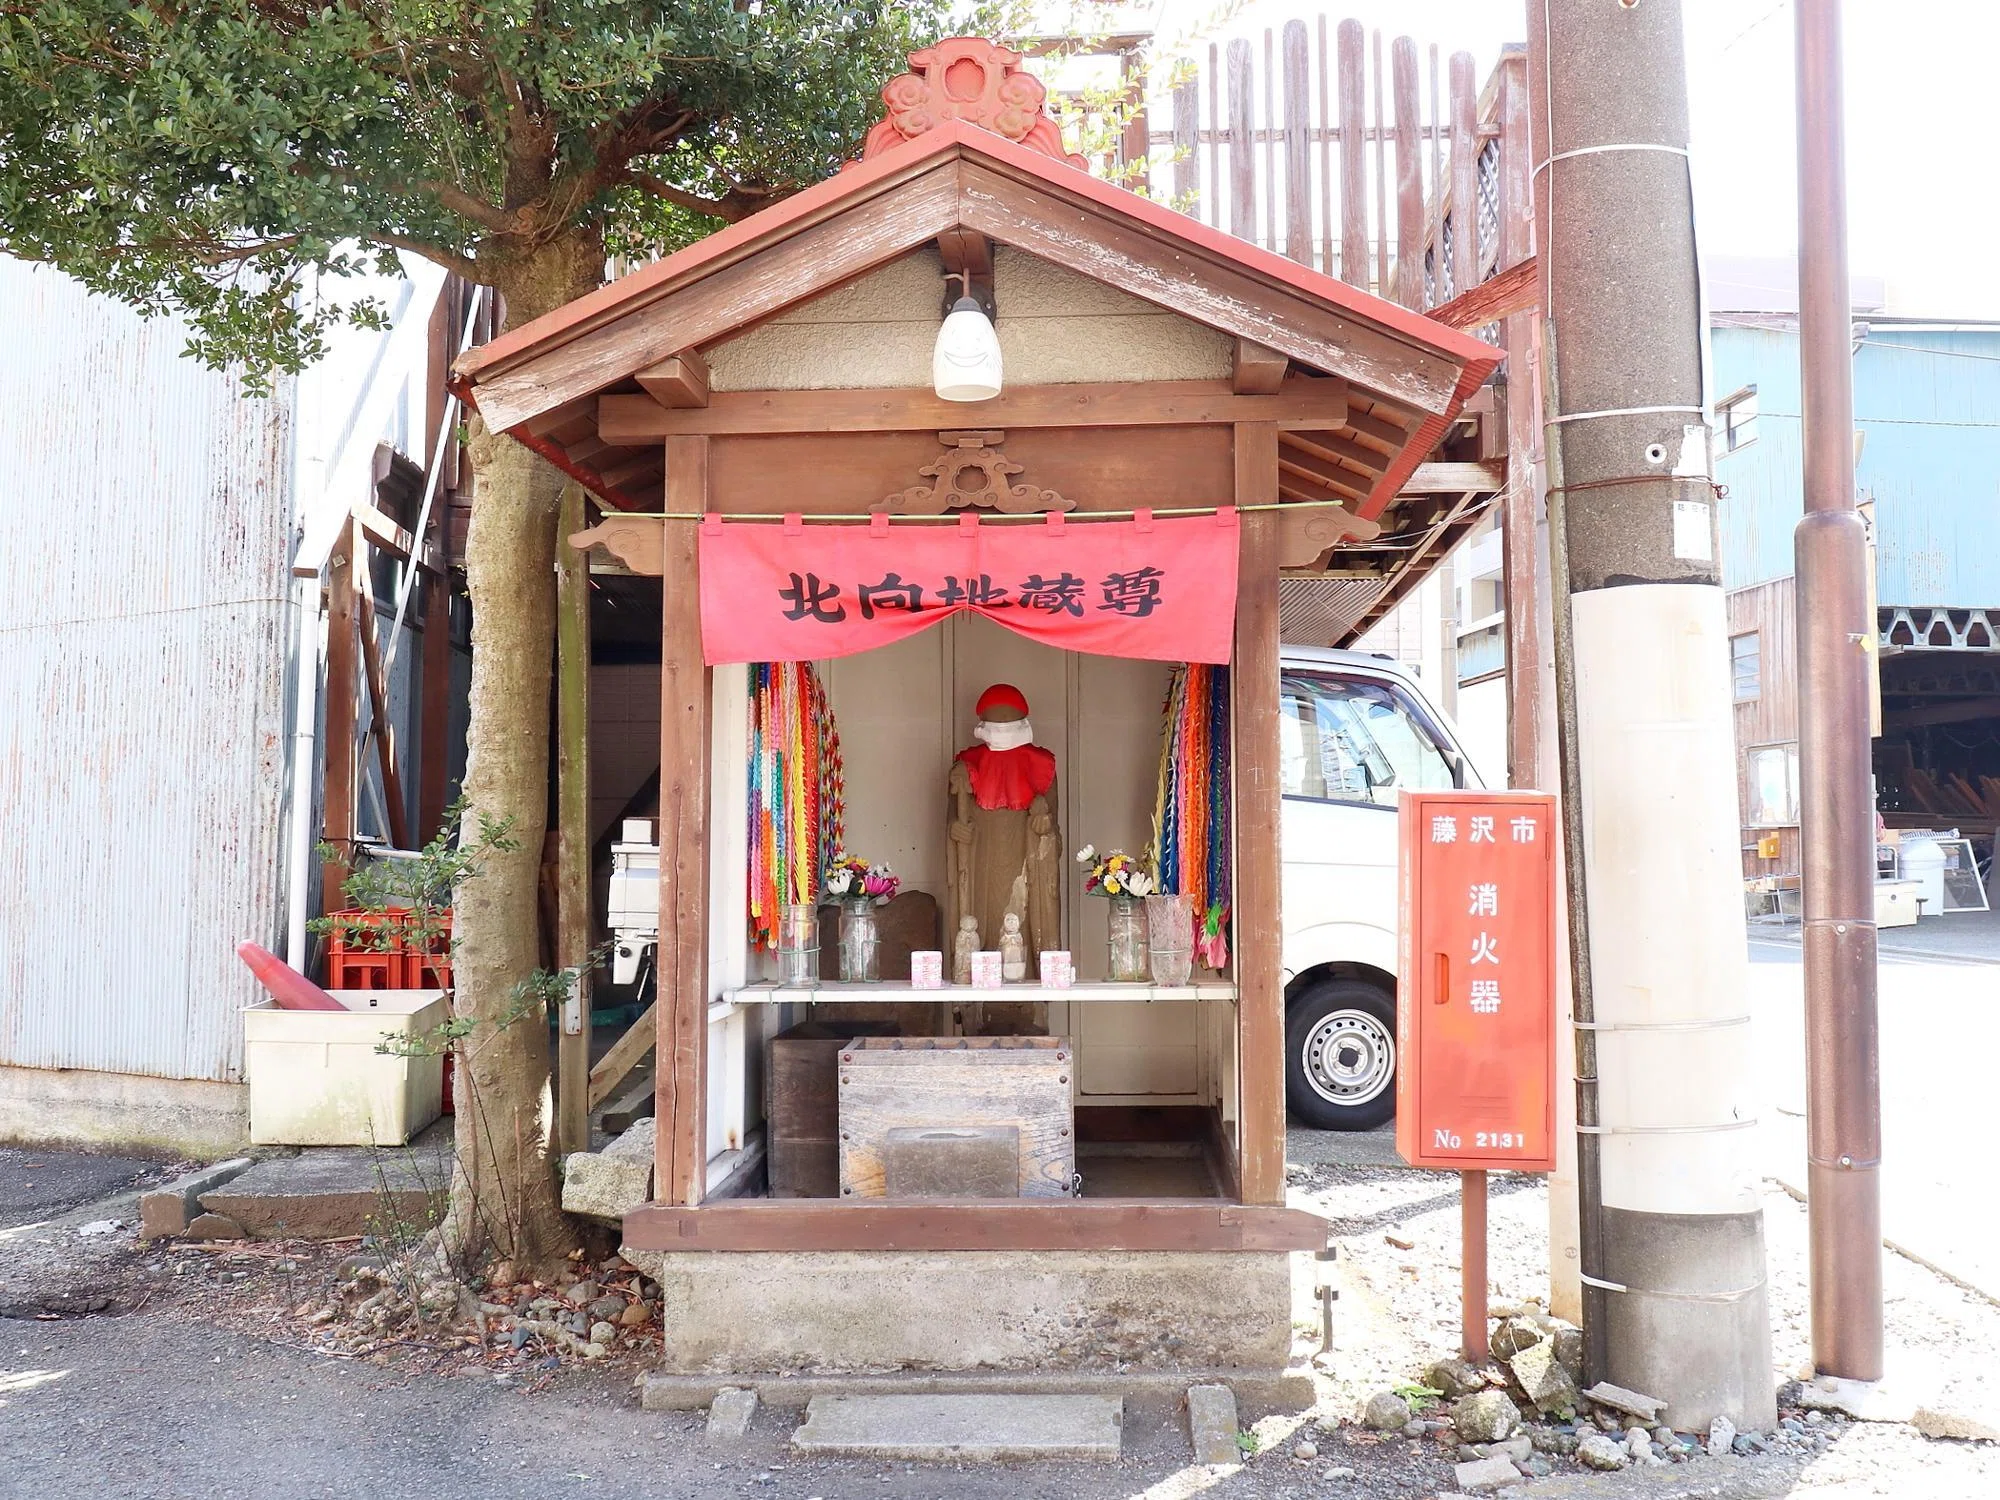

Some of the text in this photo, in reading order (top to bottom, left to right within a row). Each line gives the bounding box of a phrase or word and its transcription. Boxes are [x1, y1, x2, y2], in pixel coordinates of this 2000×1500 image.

[779, 567, 1165, 621] 北向地蔵尊
[1431, 815, 1537, 844] 藤沢市
[1467, 882, 1502, 1013] 消火器
[1433, 1128, 1525, 1149] No 2131
